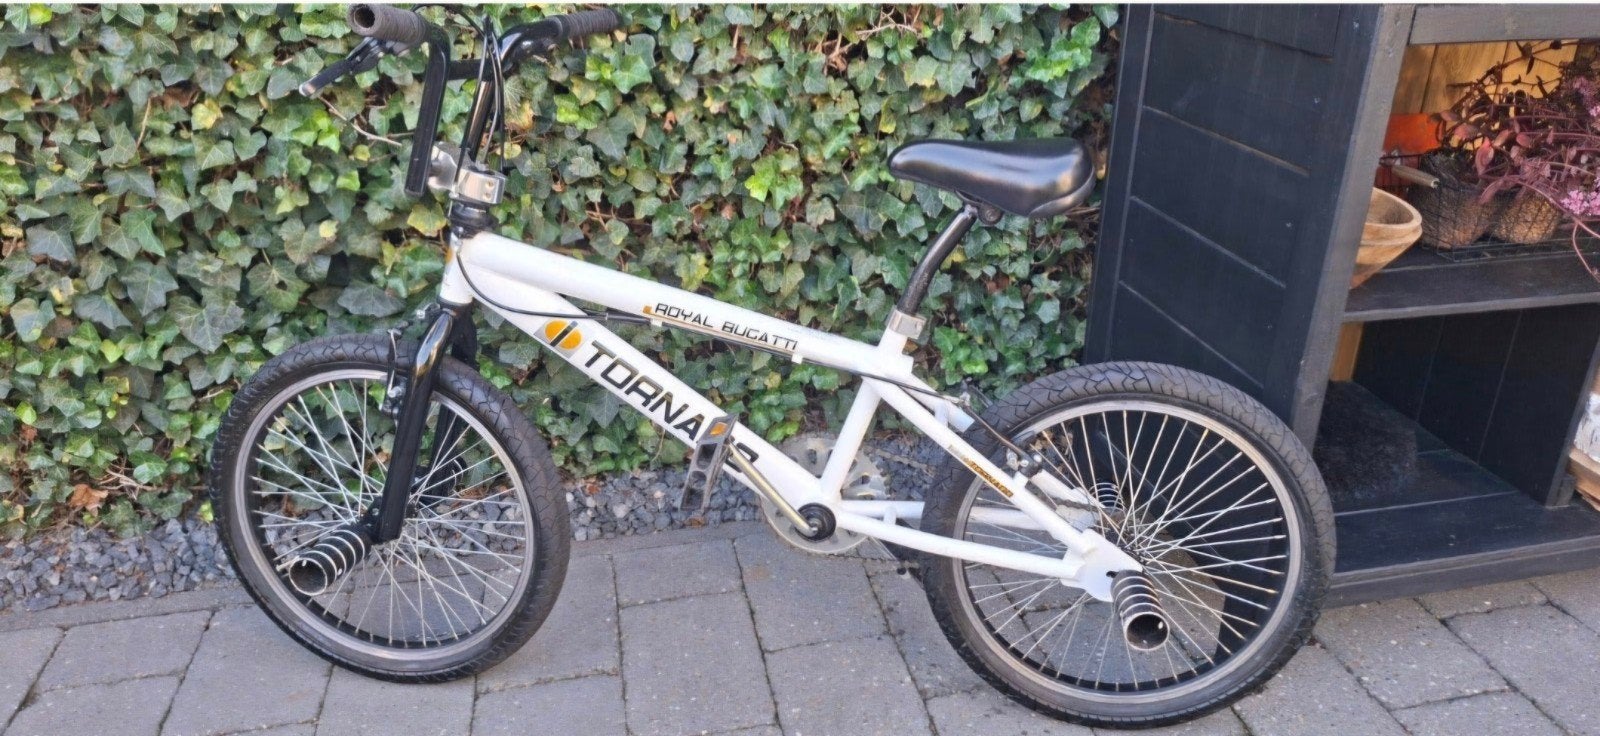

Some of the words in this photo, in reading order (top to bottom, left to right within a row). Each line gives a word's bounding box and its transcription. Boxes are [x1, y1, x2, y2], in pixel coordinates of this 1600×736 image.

[655, 303, 713, 328] ROYAL
[721, 321, 798, 350] BUGATTI
[585, 340, 759, 473] TORNAO
